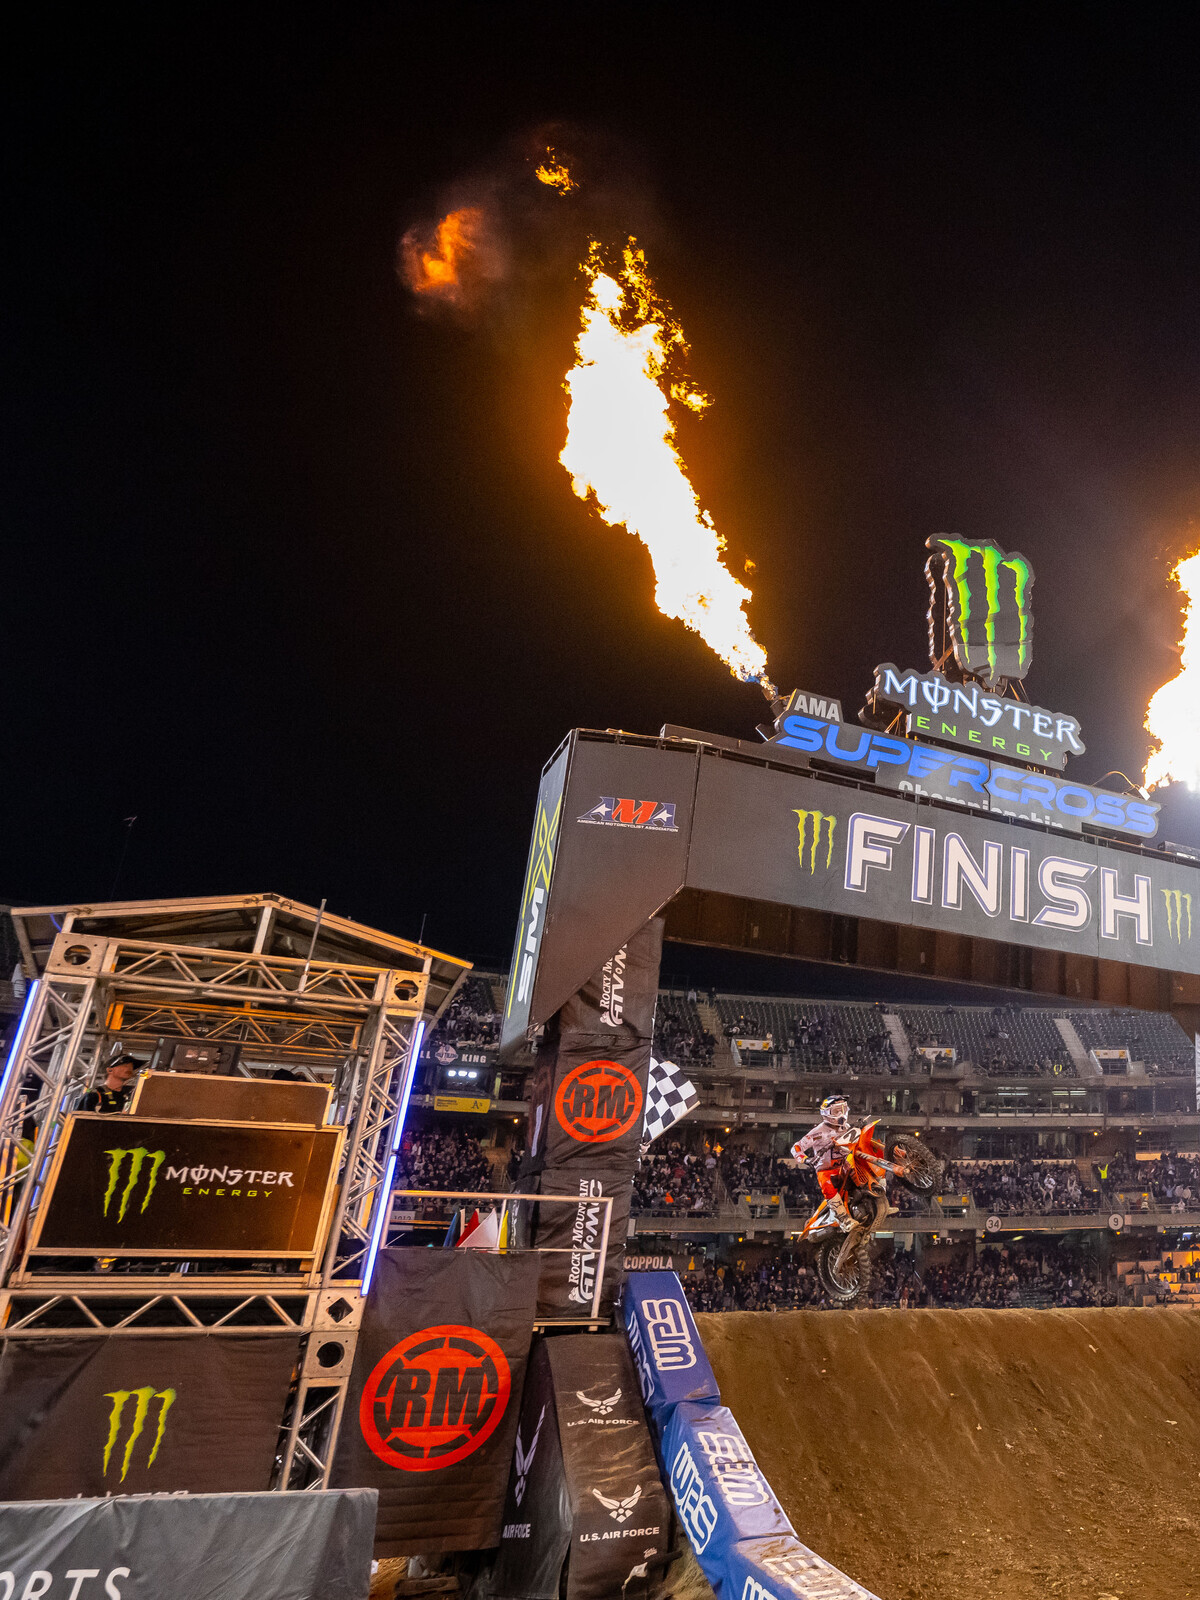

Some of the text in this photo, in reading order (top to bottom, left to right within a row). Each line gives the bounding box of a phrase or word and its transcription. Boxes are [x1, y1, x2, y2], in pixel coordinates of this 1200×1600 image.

[794, 694, 841, 722] AMA
[917, 715, 1053, 761] ENERGY
[776, 714, 1159, 833] SUPERCROSS
[576, 796, 680, 828] AMA
[844, 812, 1154, 946] FINISH
[600, 974, 612, 1010] ROCKY
[461, 1053, 487, 1064] KING
[571, 1083, 628, 1119] RM
[182, 1187, 273, 1198] ENERGY
[988, 1219, 1000, 1229] 34
[1113, 1217, 1119, 1227] 9
[569, 1245, 581, 1285] ROCKY
[624, 1256, 674, 1270] COPPOLA
[641, 1298, 697, 1371] WPS
[391, 1367, 484, 1428] RM
[515, 1523, 532, 1538] FOCE
[580, 1526, 661, 1543] U.S. AIR FORCE
